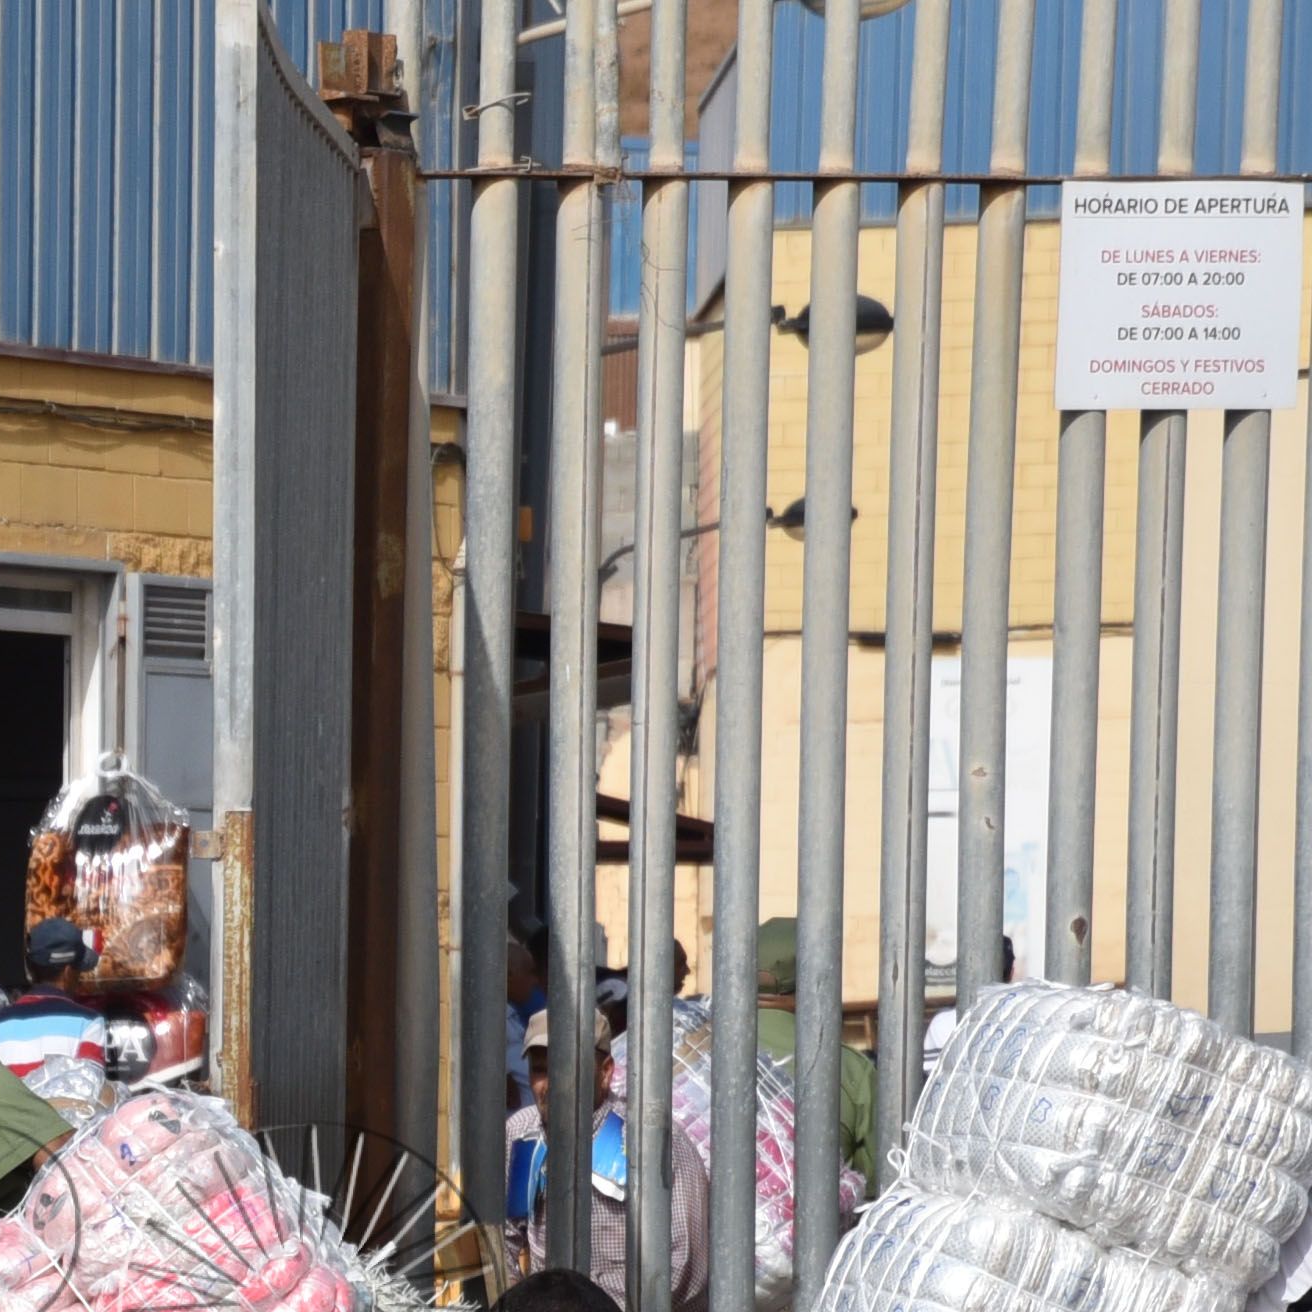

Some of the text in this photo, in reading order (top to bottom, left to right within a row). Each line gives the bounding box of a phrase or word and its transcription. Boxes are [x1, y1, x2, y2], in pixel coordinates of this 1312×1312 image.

[1074, 197, 1290, 216] HORARIO DE APERTURA
[1101, 249, 1262, 264] DE LUNES A VIERNES:
[1117, 271, 1245, 286] DE 07:00 A 20:00
[1140, 302, 1219, 319] SÁBADOS:
[1117, 326, 1241, 341] DE 07:00 A 14:00
[1089, 359, 1265, 374] DOMINGOS Y FESTIVOS
[1140, 381, 1215, 396] CERRADO
